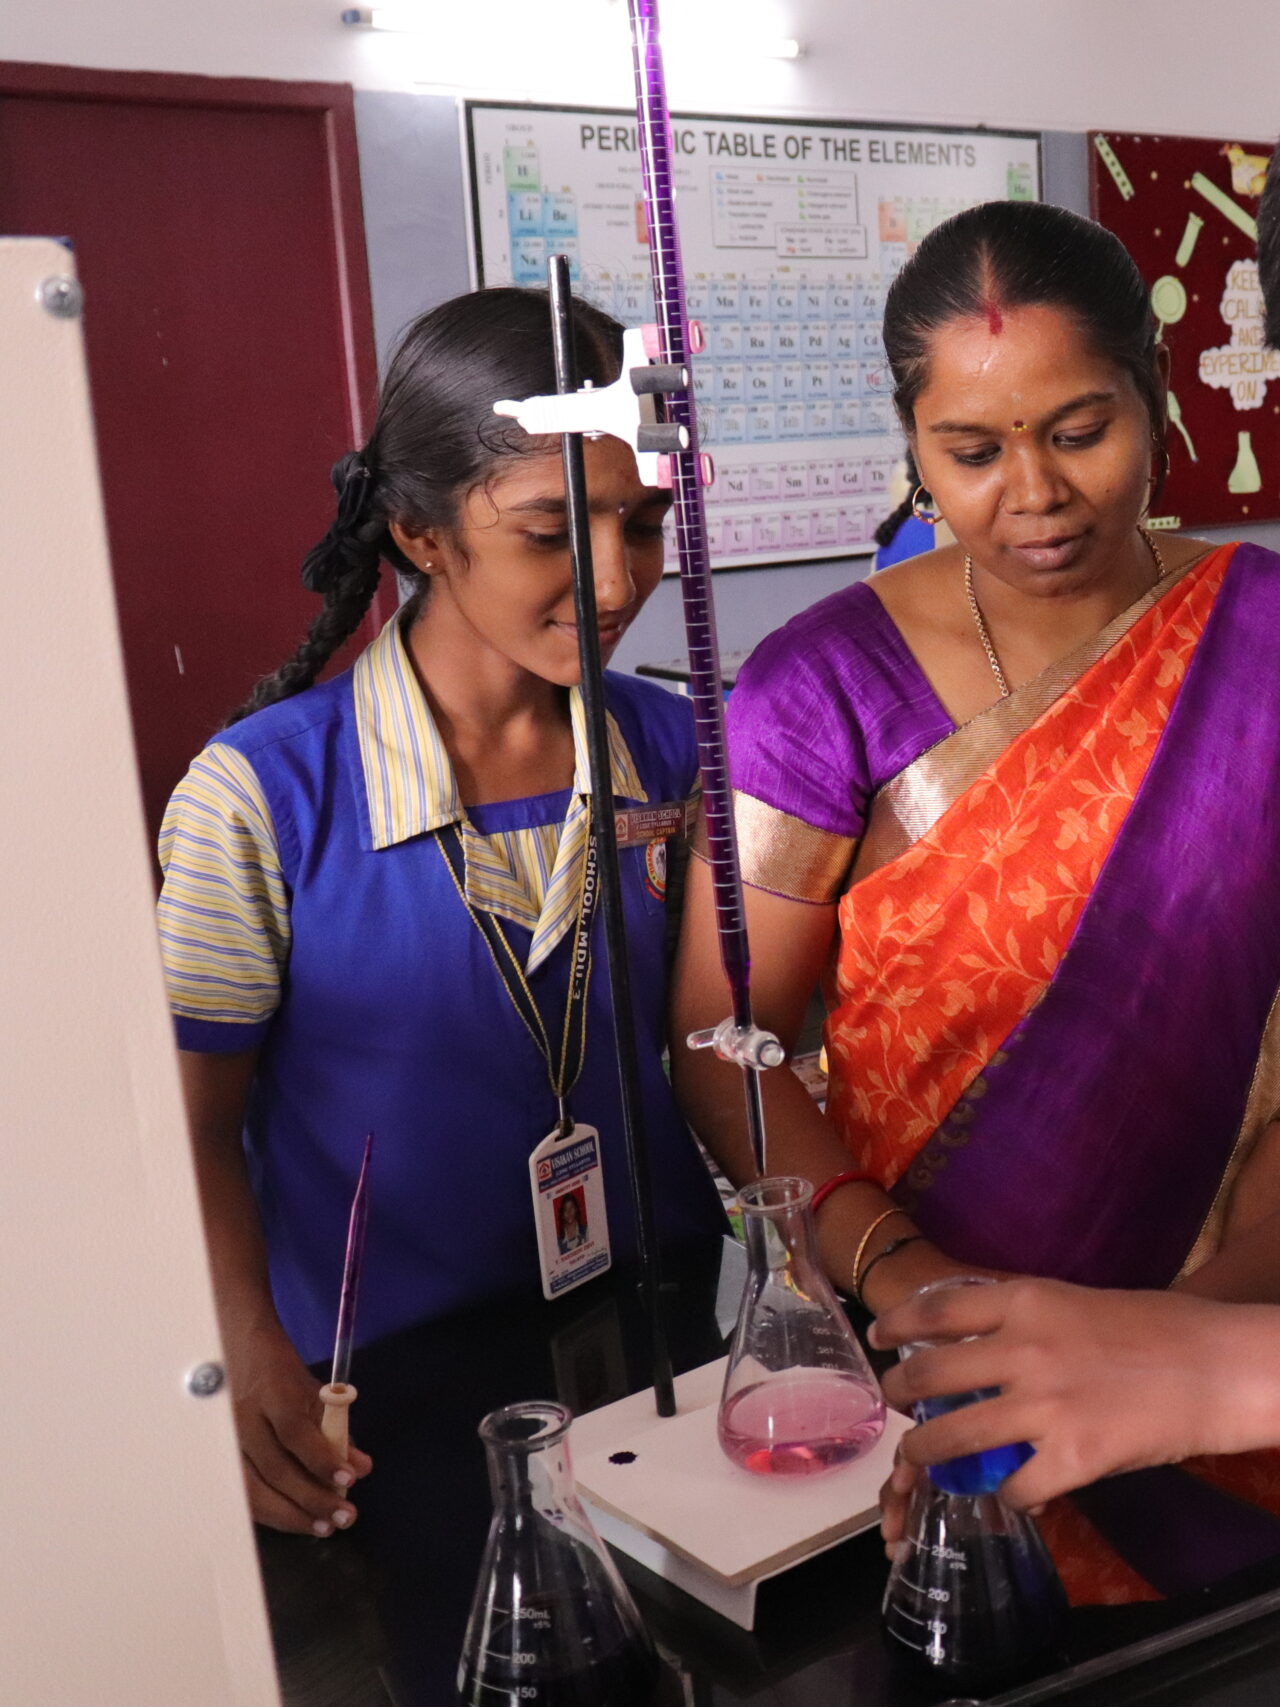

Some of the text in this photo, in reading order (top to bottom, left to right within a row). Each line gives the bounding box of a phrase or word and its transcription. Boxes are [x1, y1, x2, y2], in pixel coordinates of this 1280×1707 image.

[580, 124, 977, 167] PERIIC TABLE OF THE ELEMENTS
[519, 208, 533, 221] Li
[552, 208, 568, 221] Be
[520, 253, 537, 266] Na
[1230, 269, 1259, 292] KEE
[716, 295, 734, 308] Mn
[749, 295, 762, 307] Fe
[808, 295, 820, 307] Ni
[863, 295, 876, 307] Zn
[749, 336, 765, 348] Ru
[779, 336, 794, 348] Rh
[808, 335, 822, 347] Pd
[837, 336, 850, 349] Ag
[863, 335, 878, 346] Cd
[722, 378, 737, 390] Re
[752, 377, 767, 389] Os
[783, 376, 793, 388] Ir
[812, 375, 823, 387] Pt
[839, 375, 853, 386] Au
[1236, 380, 1257, 402] ON
[815, 474, 830, 486] Eu
[842, 472, 858, 484] Gd
[871, 469, 885, 482] Tb
[727, 480, 743, 492] Nd
[785, 476, 802, 489] Sm
[733, 530, 743, 542] U
[572, 835, 597, 1000] SCHOOL, MDU-3
[927, 1586, 950, 1603] 200
[926, 1619, 948, 1635] 150
[512, 1652, 536, 1665] 200
[514, 1686, 538, 1699] 150
